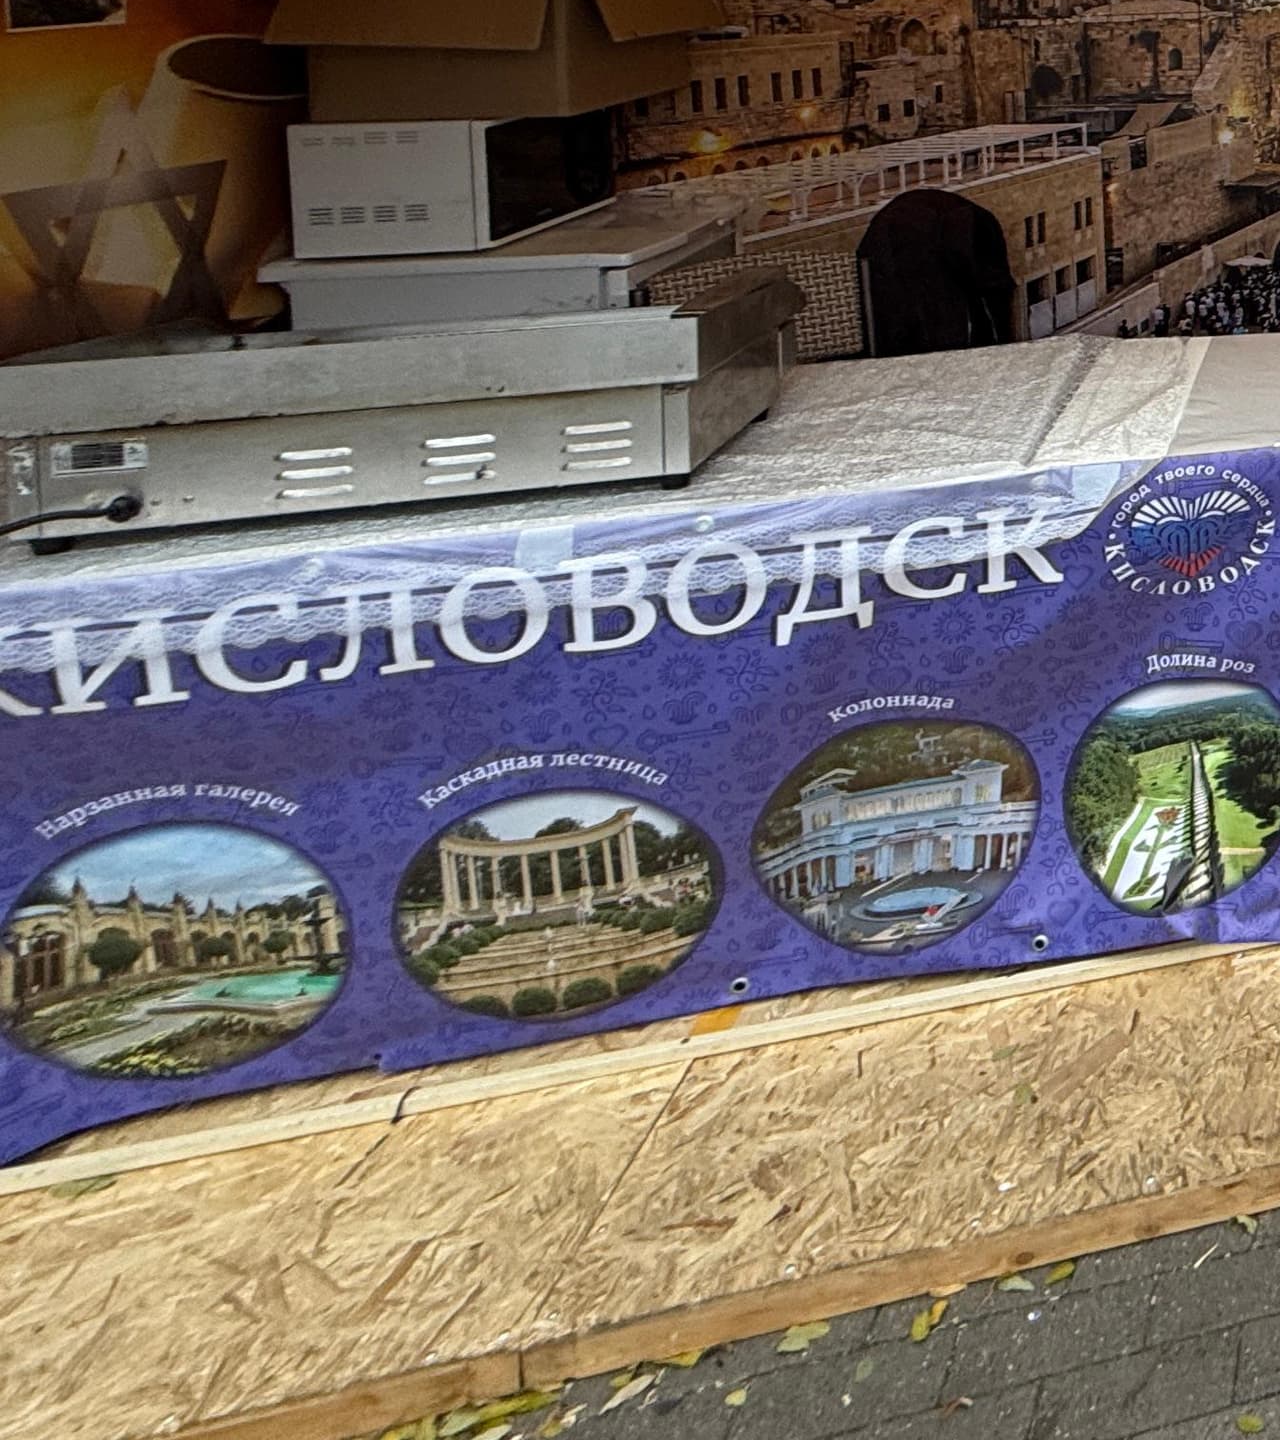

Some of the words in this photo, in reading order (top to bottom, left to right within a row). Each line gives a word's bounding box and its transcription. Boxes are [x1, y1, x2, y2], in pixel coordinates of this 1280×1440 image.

[1111, 484, 1152, 529] город
[1154, 464, 1216, 485] твоего
[1222, 469, 1271, 508] сердца
[1104, 519, 1276, 595] КИСЛОВОДСК
[1146, 653, 1217, 675] Долина
[1219, 658, 1256, 674] роз
[827, 694, 955, 723] Колоннада
[417, 753, 544, 810] Каскадная
[549, 750, 669, 786] лестница
[34, 783, 187, 841] Нарзанная
[194, 782, 301, 817] галерея
